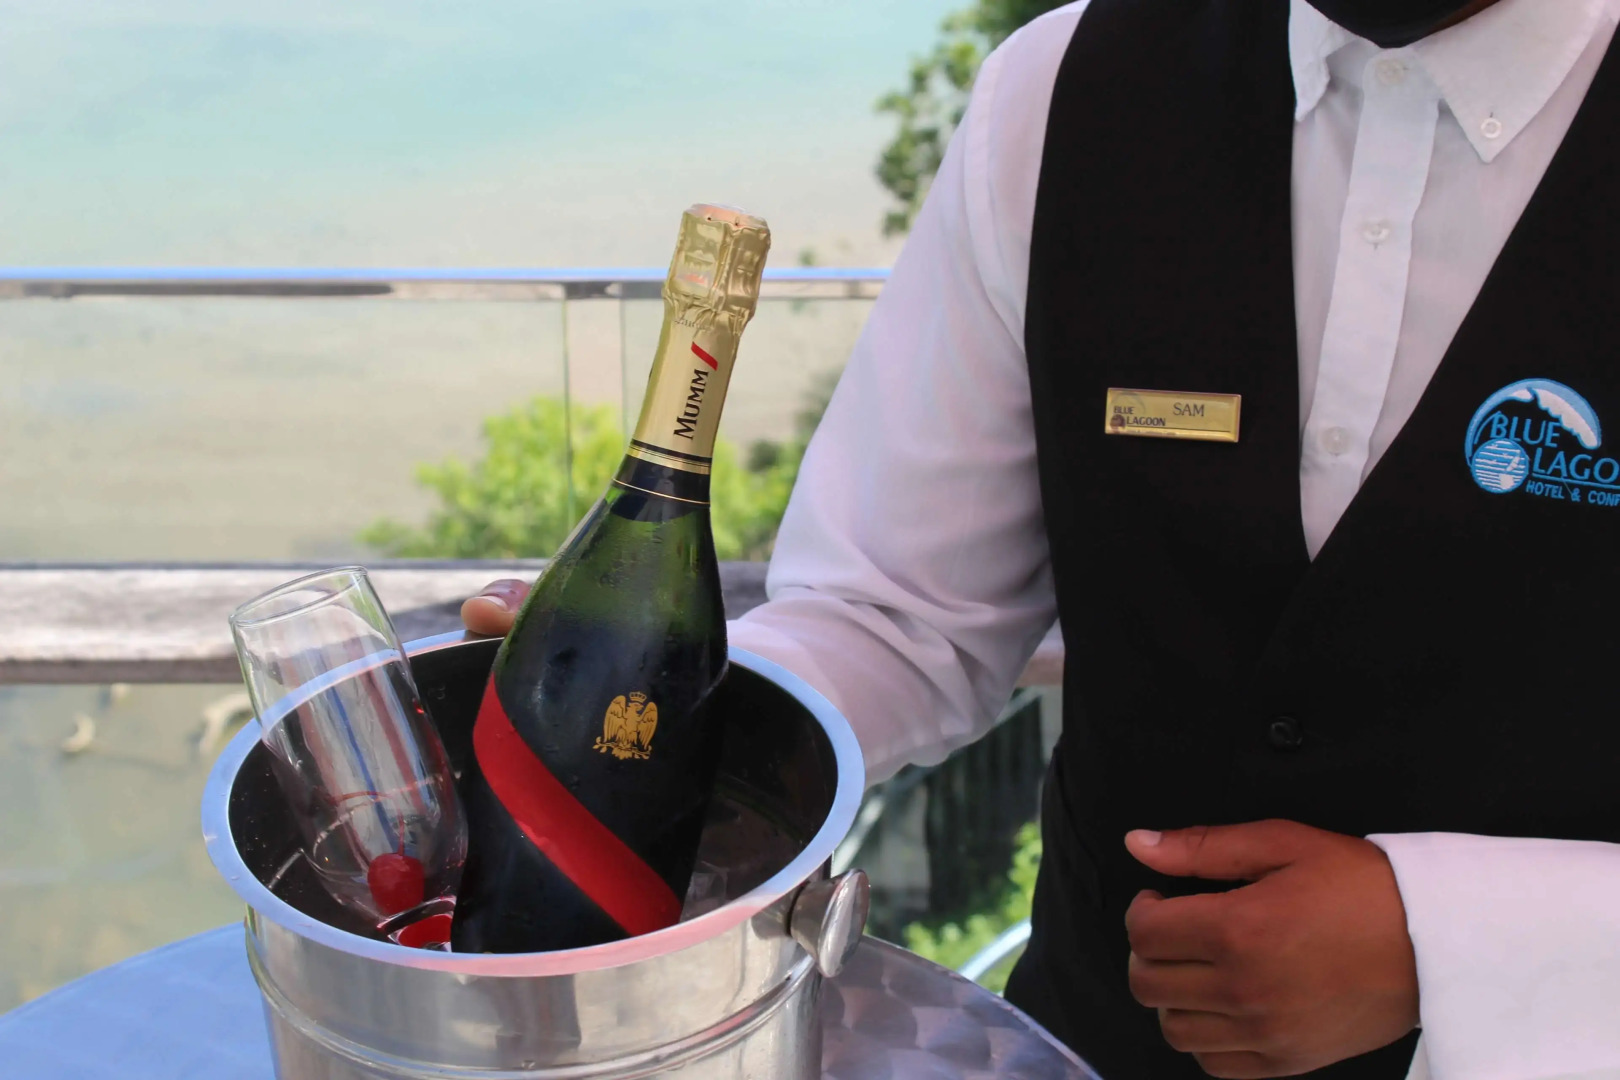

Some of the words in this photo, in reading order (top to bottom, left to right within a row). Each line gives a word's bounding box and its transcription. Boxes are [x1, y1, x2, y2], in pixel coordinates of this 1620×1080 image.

[673, 369, 709, 441] MUMM
[1113, 405, 1135, 415] BLUE
[1173, 402, 1205, 417] SAM
[1126, 415, 1167, 427] LAGOON
[1490, 411, 1561, 448] BLUE
[1532, 447, 1620, 484] LAGO
[1526, 480, 1565, 499] HOTEL
[1570, 487, 1581, 502] &
